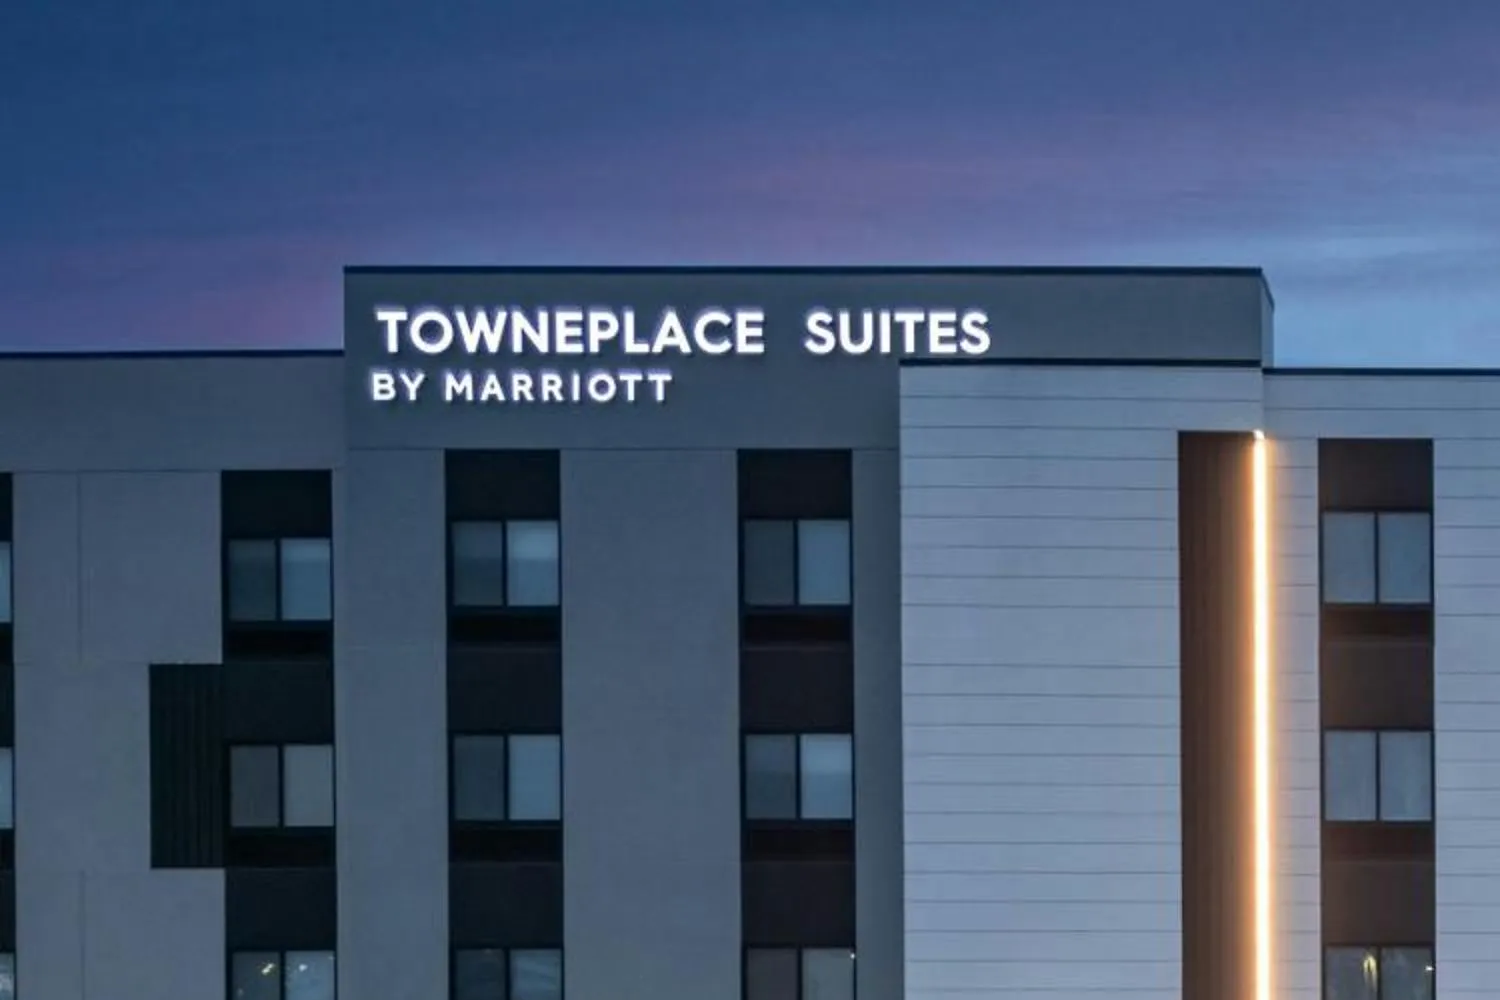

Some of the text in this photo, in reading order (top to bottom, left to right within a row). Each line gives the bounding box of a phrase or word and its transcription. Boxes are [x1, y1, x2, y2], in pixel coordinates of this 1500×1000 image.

[375, 310, 991, 355] TOWNEPLACE SUITES
[371, 371, 673, 402] BY MARRIOTT
